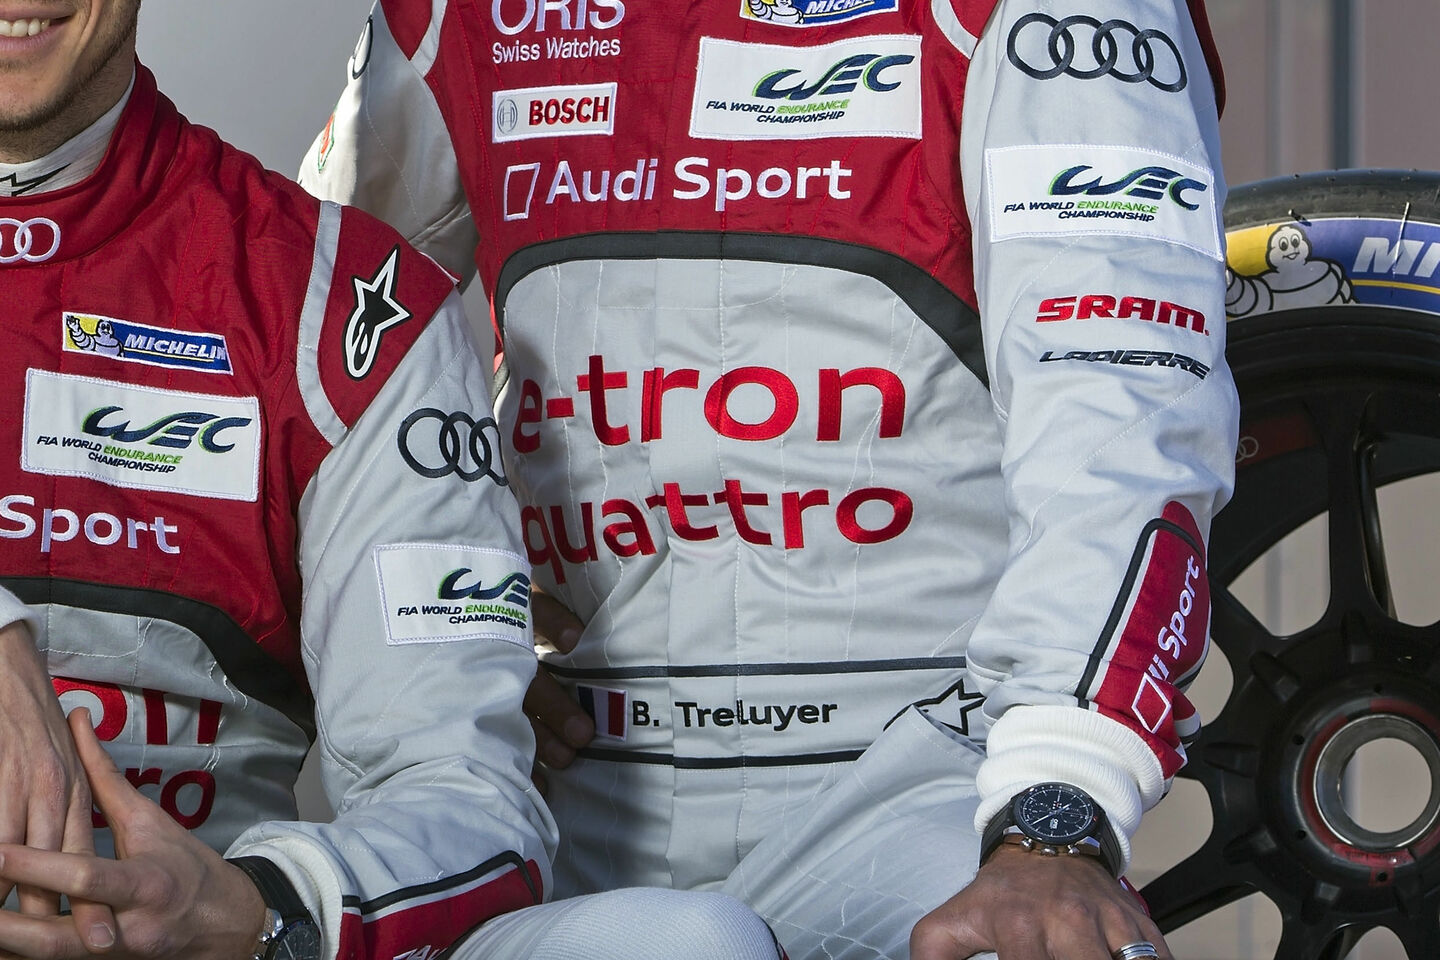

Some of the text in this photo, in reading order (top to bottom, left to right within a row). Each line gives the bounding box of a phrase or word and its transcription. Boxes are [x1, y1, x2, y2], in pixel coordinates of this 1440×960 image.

[491, 37, 621, 64] Swiss Watches
[752, 54, 915, 100] WEC
[528, 95, 609, 127] BOSCH
[706, 99, 850, 114] FIA WORLD ENDURANCE
[757, 111, 845, 124] CHAMPIONSHIP
[546, 156, 852, 212] Audi Sport
[1048, 164, 1208, 211] WEC
[1004, 200, 1159, 214] FIA WORLD ENDURANCE
[1058, 210, 1155, 223] CHAMPIONSHIP
[123, 333, 226, 361] MICHELIN
[1039, 349, 1211, 380] LAPIERRE
[513, 354, 906, 454] e-tron
[82, 406, 253, 454] WEC
[37, 436, 183, 464] FIA WORLD ENDURANCE
[88, 451, 176, 473] CHAMPIONSHIP
[521, 479, 913, 585] quattro
[397, 605, 528, 621] FIA WORLD ENDURANCE
[449, 614, 527, 630] CHAMPIONSHIP
[1157, 555, 1200, 660] Sport
[632, 698, 838, 732] B. Treluyer
